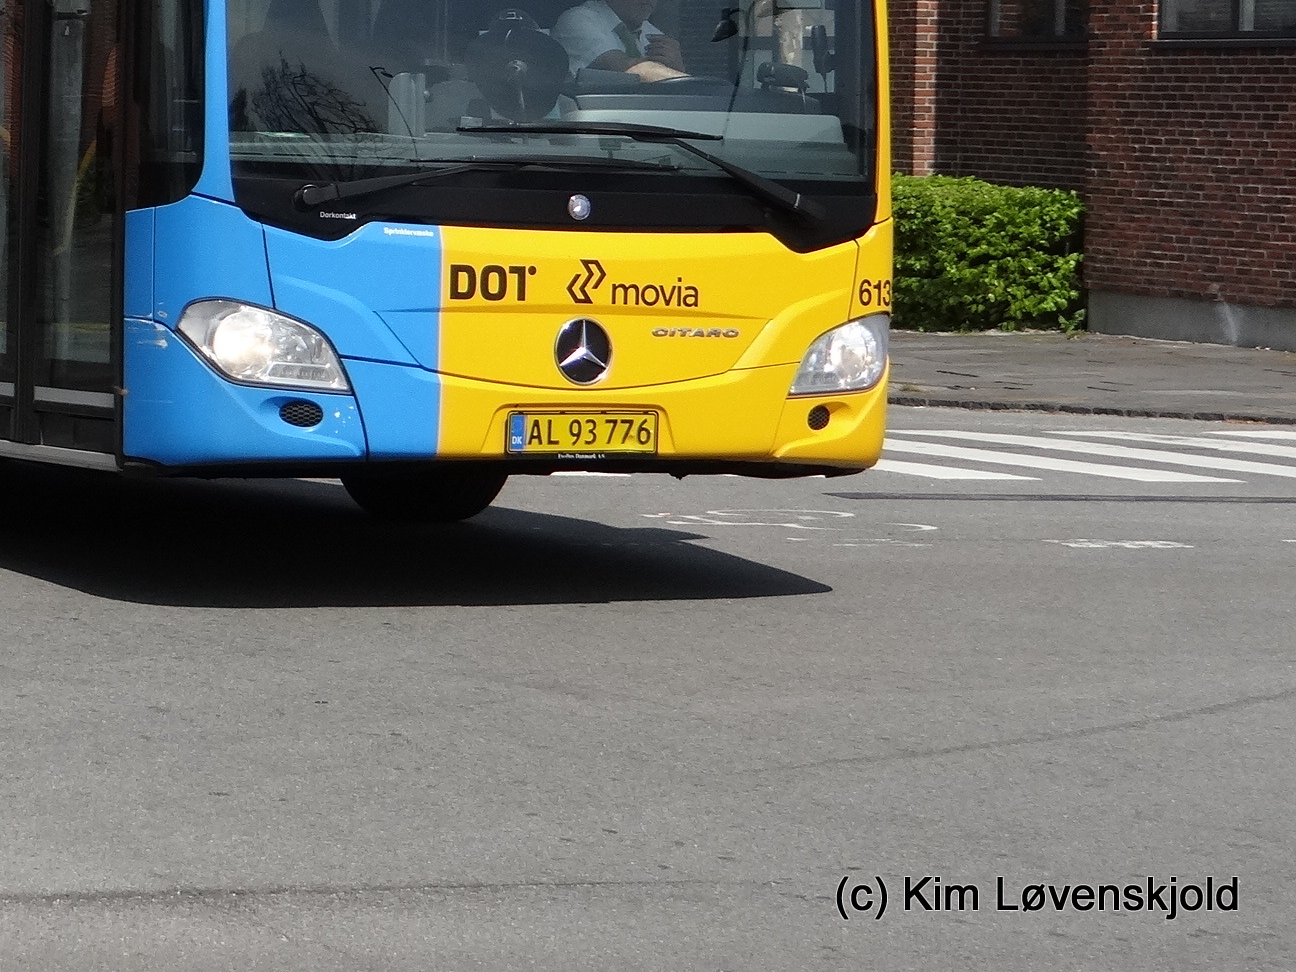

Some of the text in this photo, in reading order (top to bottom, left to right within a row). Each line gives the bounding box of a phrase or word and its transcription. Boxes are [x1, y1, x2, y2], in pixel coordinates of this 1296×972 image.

[449, 264, 537, 301] DOT
[610, 277, 700, 308] movia
[859, 279, 891, 307] 613
[651, 326, 740, 339] CITARO
[512, 418, 651, 446] DK AL 93 776
